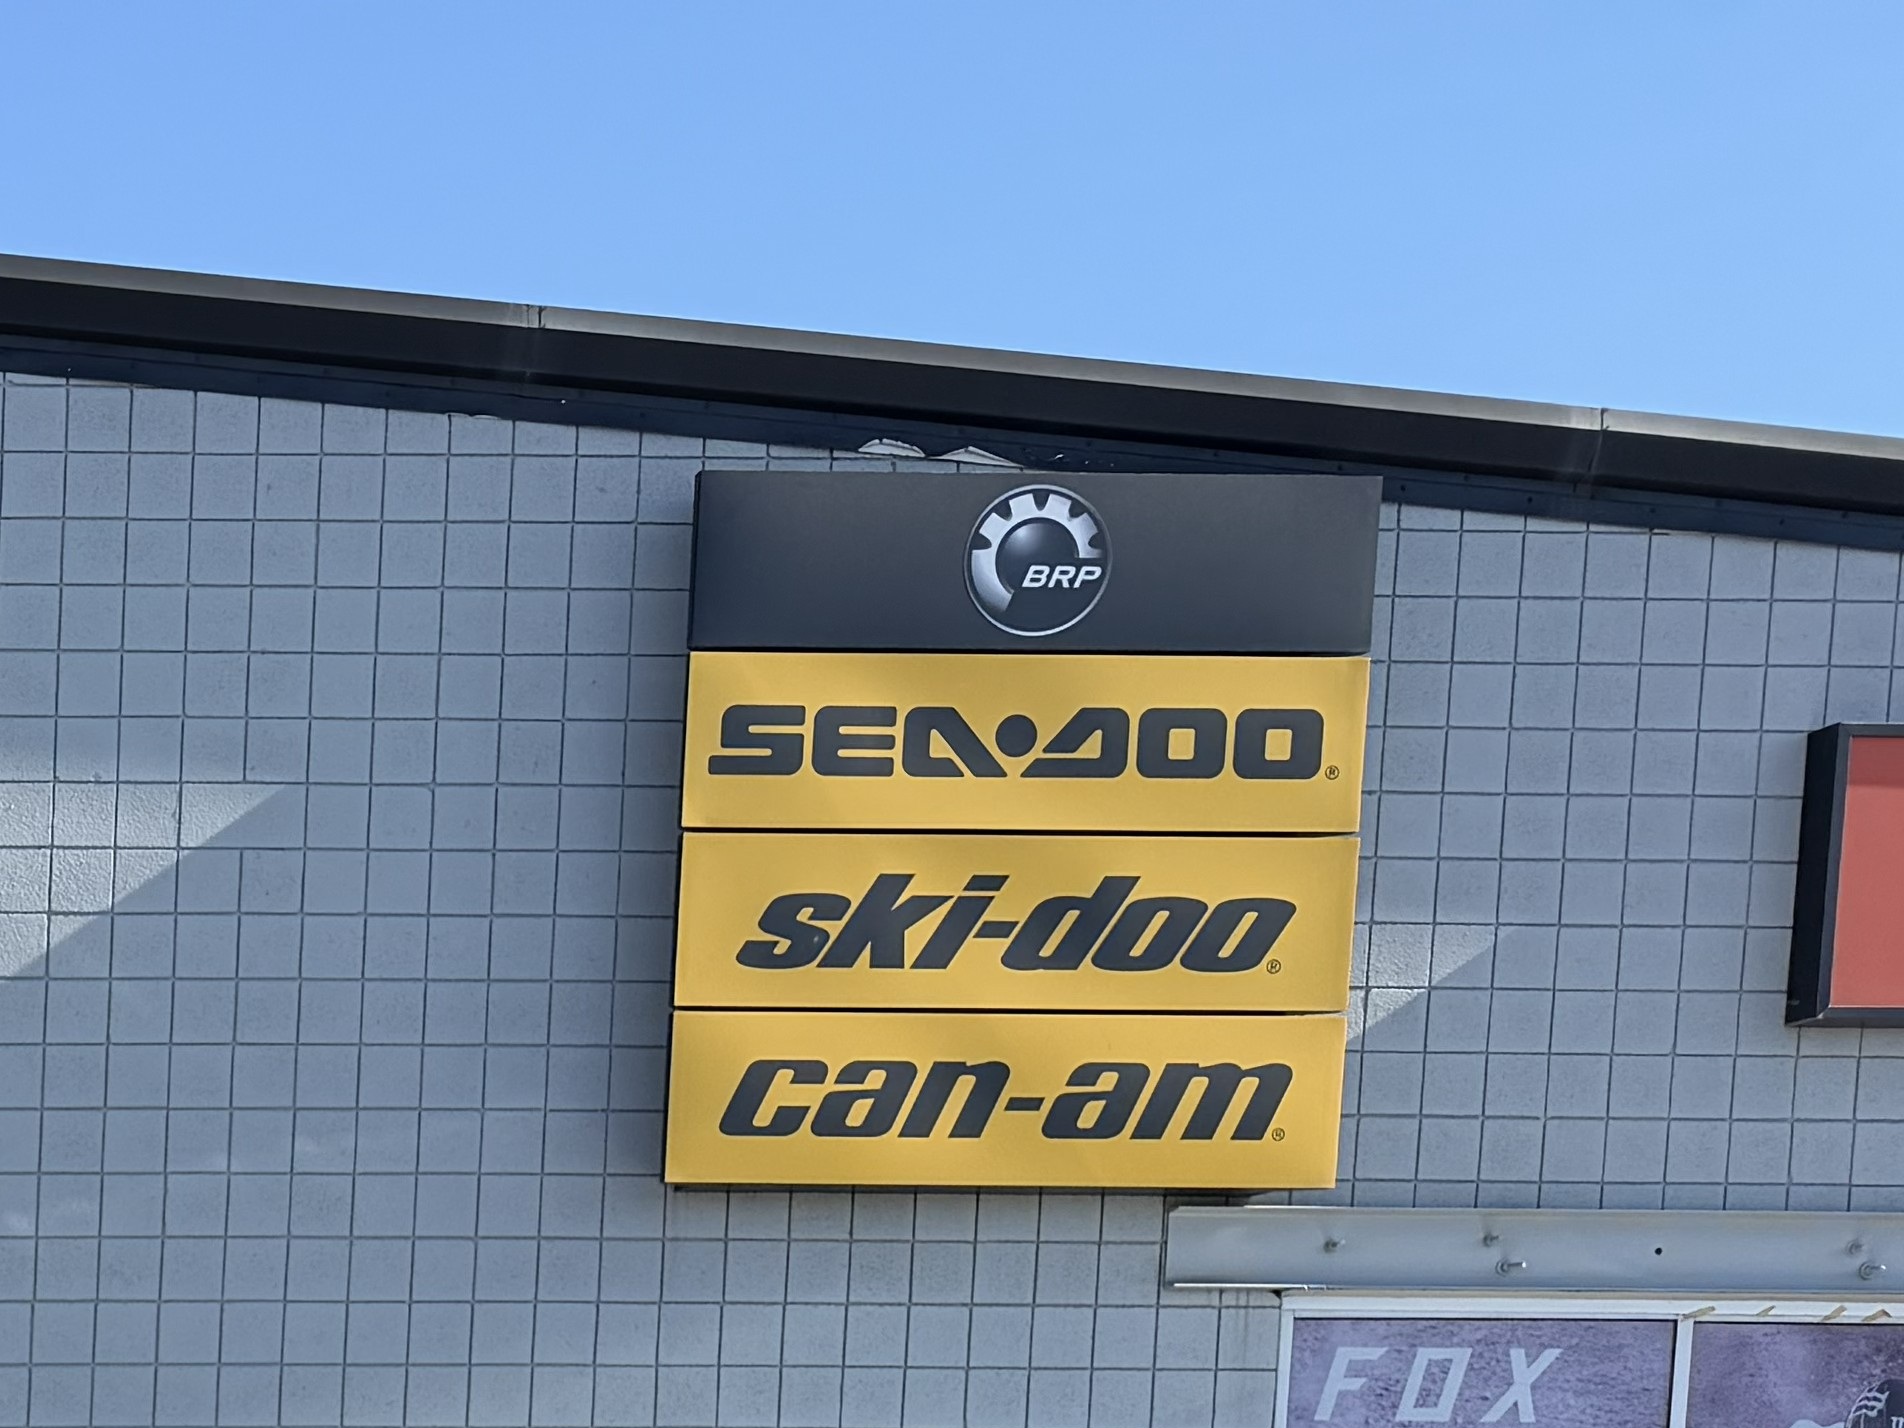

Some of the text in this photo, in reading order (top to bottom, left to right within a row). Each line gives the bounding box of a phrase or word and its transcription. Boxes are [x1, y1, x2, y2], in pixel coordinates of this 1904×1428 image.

[1021, 564, 1103, 589] BRP
[735, 872, 1297, 973] ski-doo
[718, 1058, 1293, 1141] can-am
[1313, 1346, 1565, 1424] FOX
